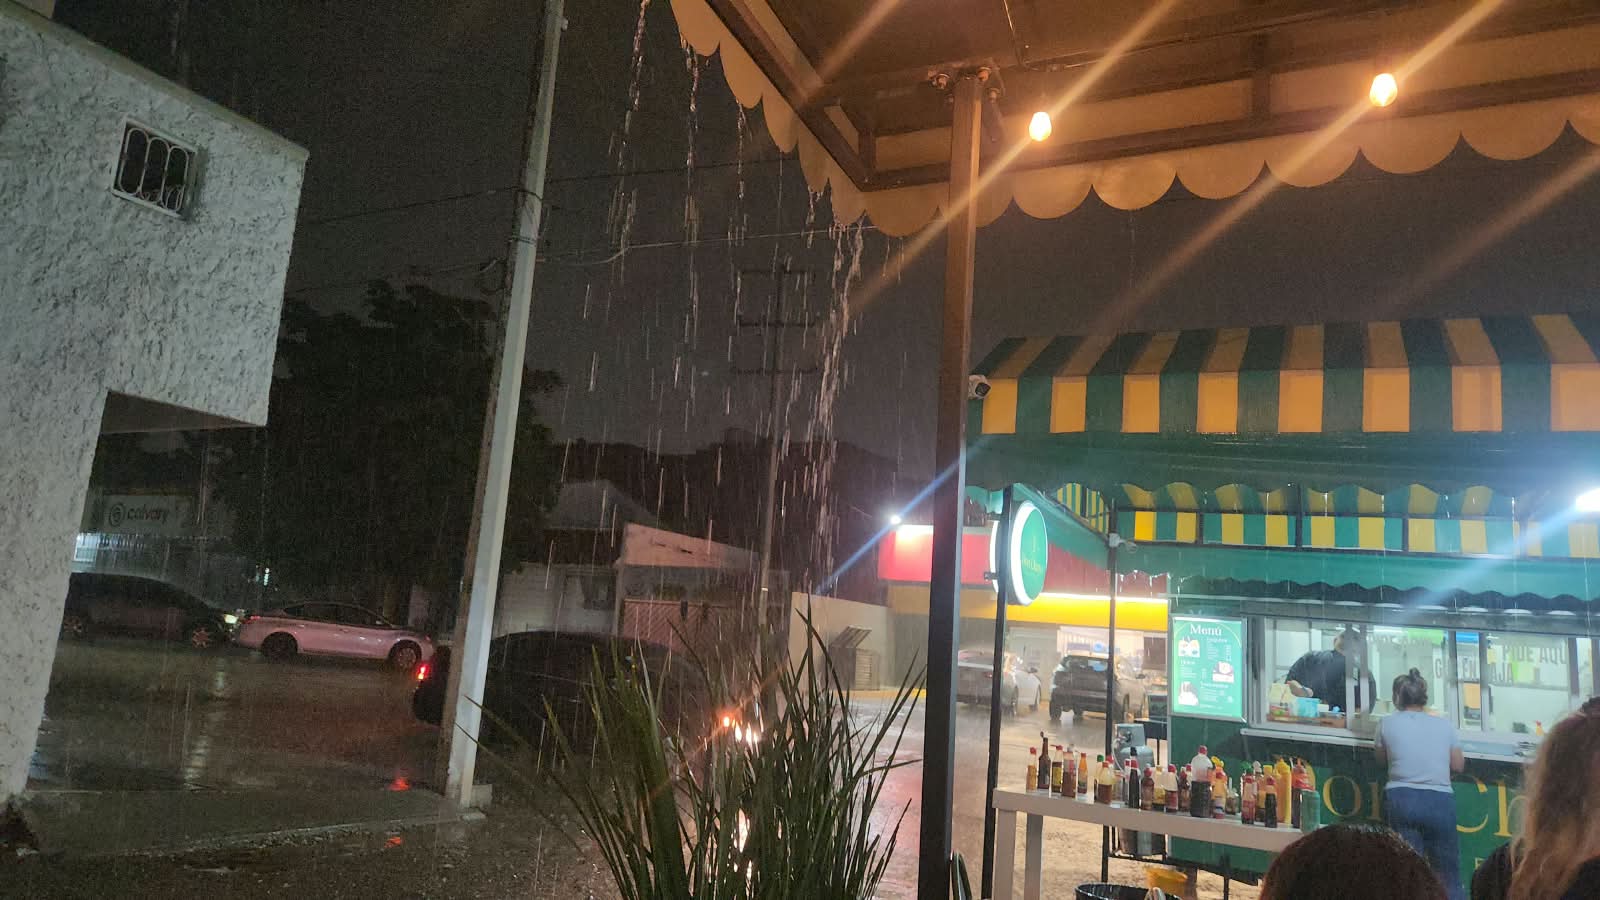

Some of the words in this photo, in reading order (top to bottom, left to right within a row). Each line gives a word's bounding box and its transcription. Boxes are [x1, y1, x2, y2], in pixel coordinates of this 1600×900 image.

[1190, 623, 1222, 636] Menú
[1539, 647, 1569, 664] AQU
[1489, 662, 1513, 683] AJA
